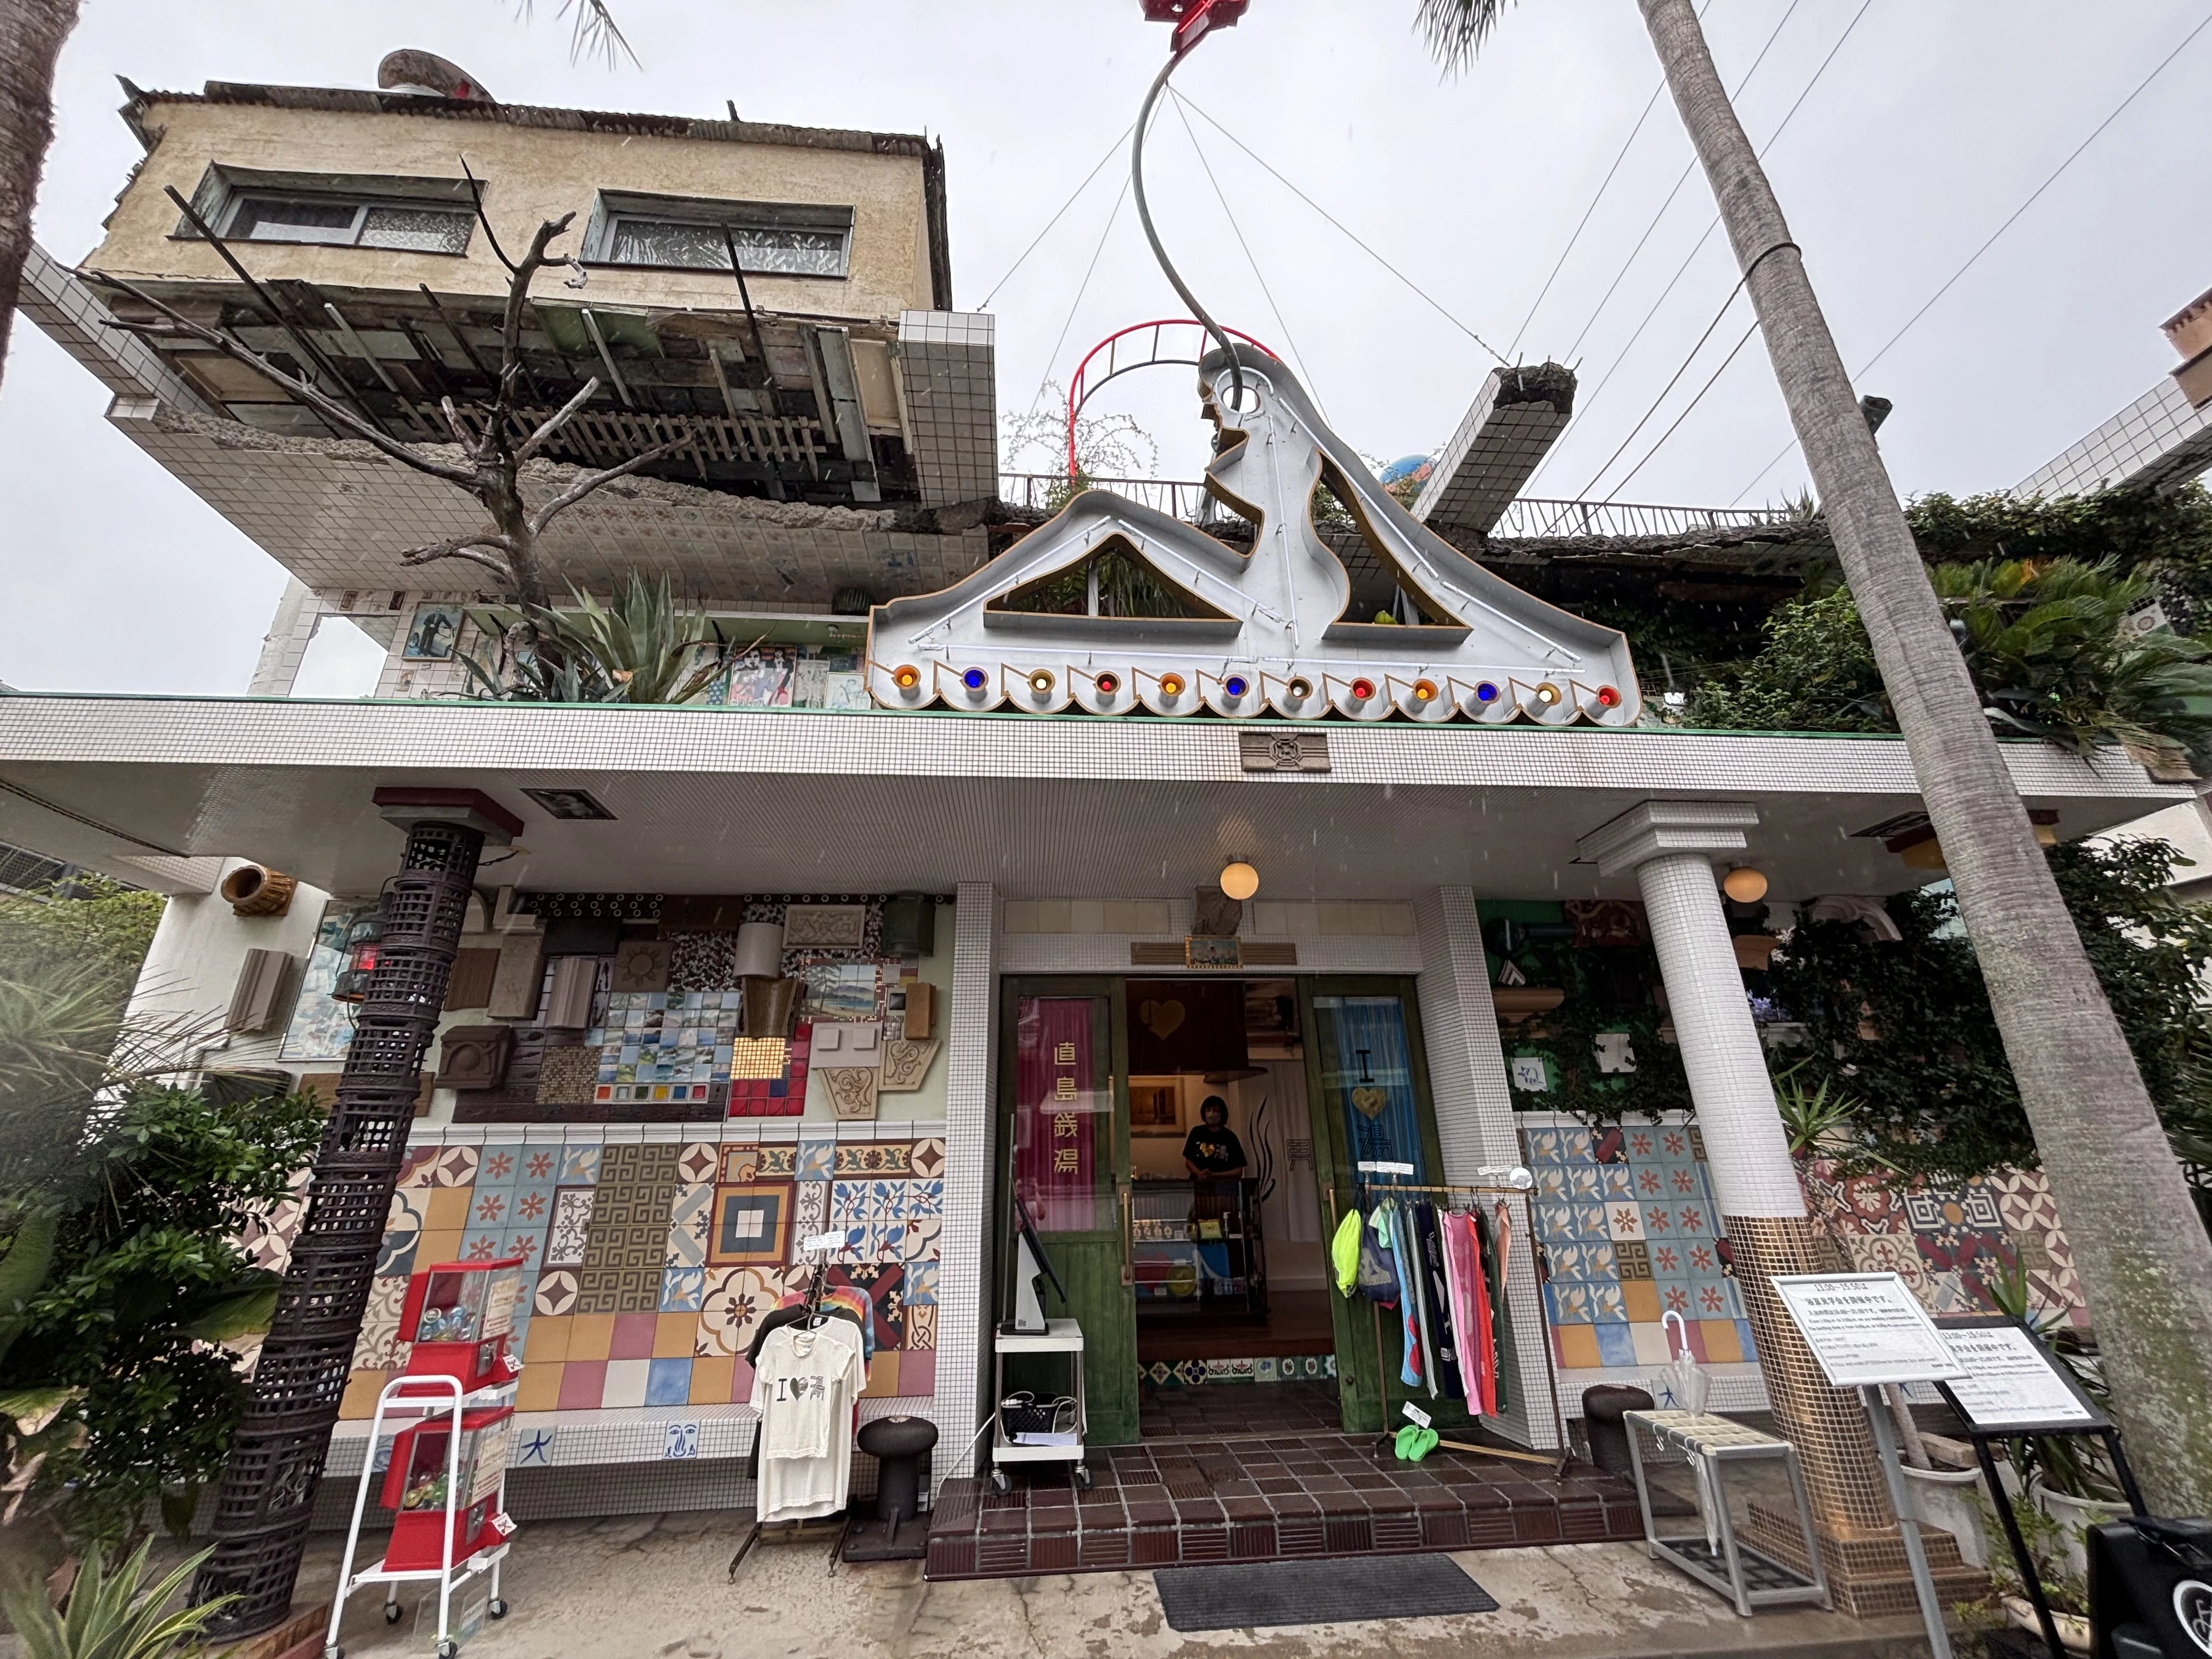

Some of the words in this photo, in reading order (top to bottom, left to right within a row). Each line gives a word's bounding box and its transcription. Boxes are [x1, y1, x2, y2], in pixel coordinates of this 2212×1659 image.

[1355, 1049, 1375, 1083] I
[1054, 1041, 1078, 1175] 直島銭湯
[776, 1378, 788, 1402] I
